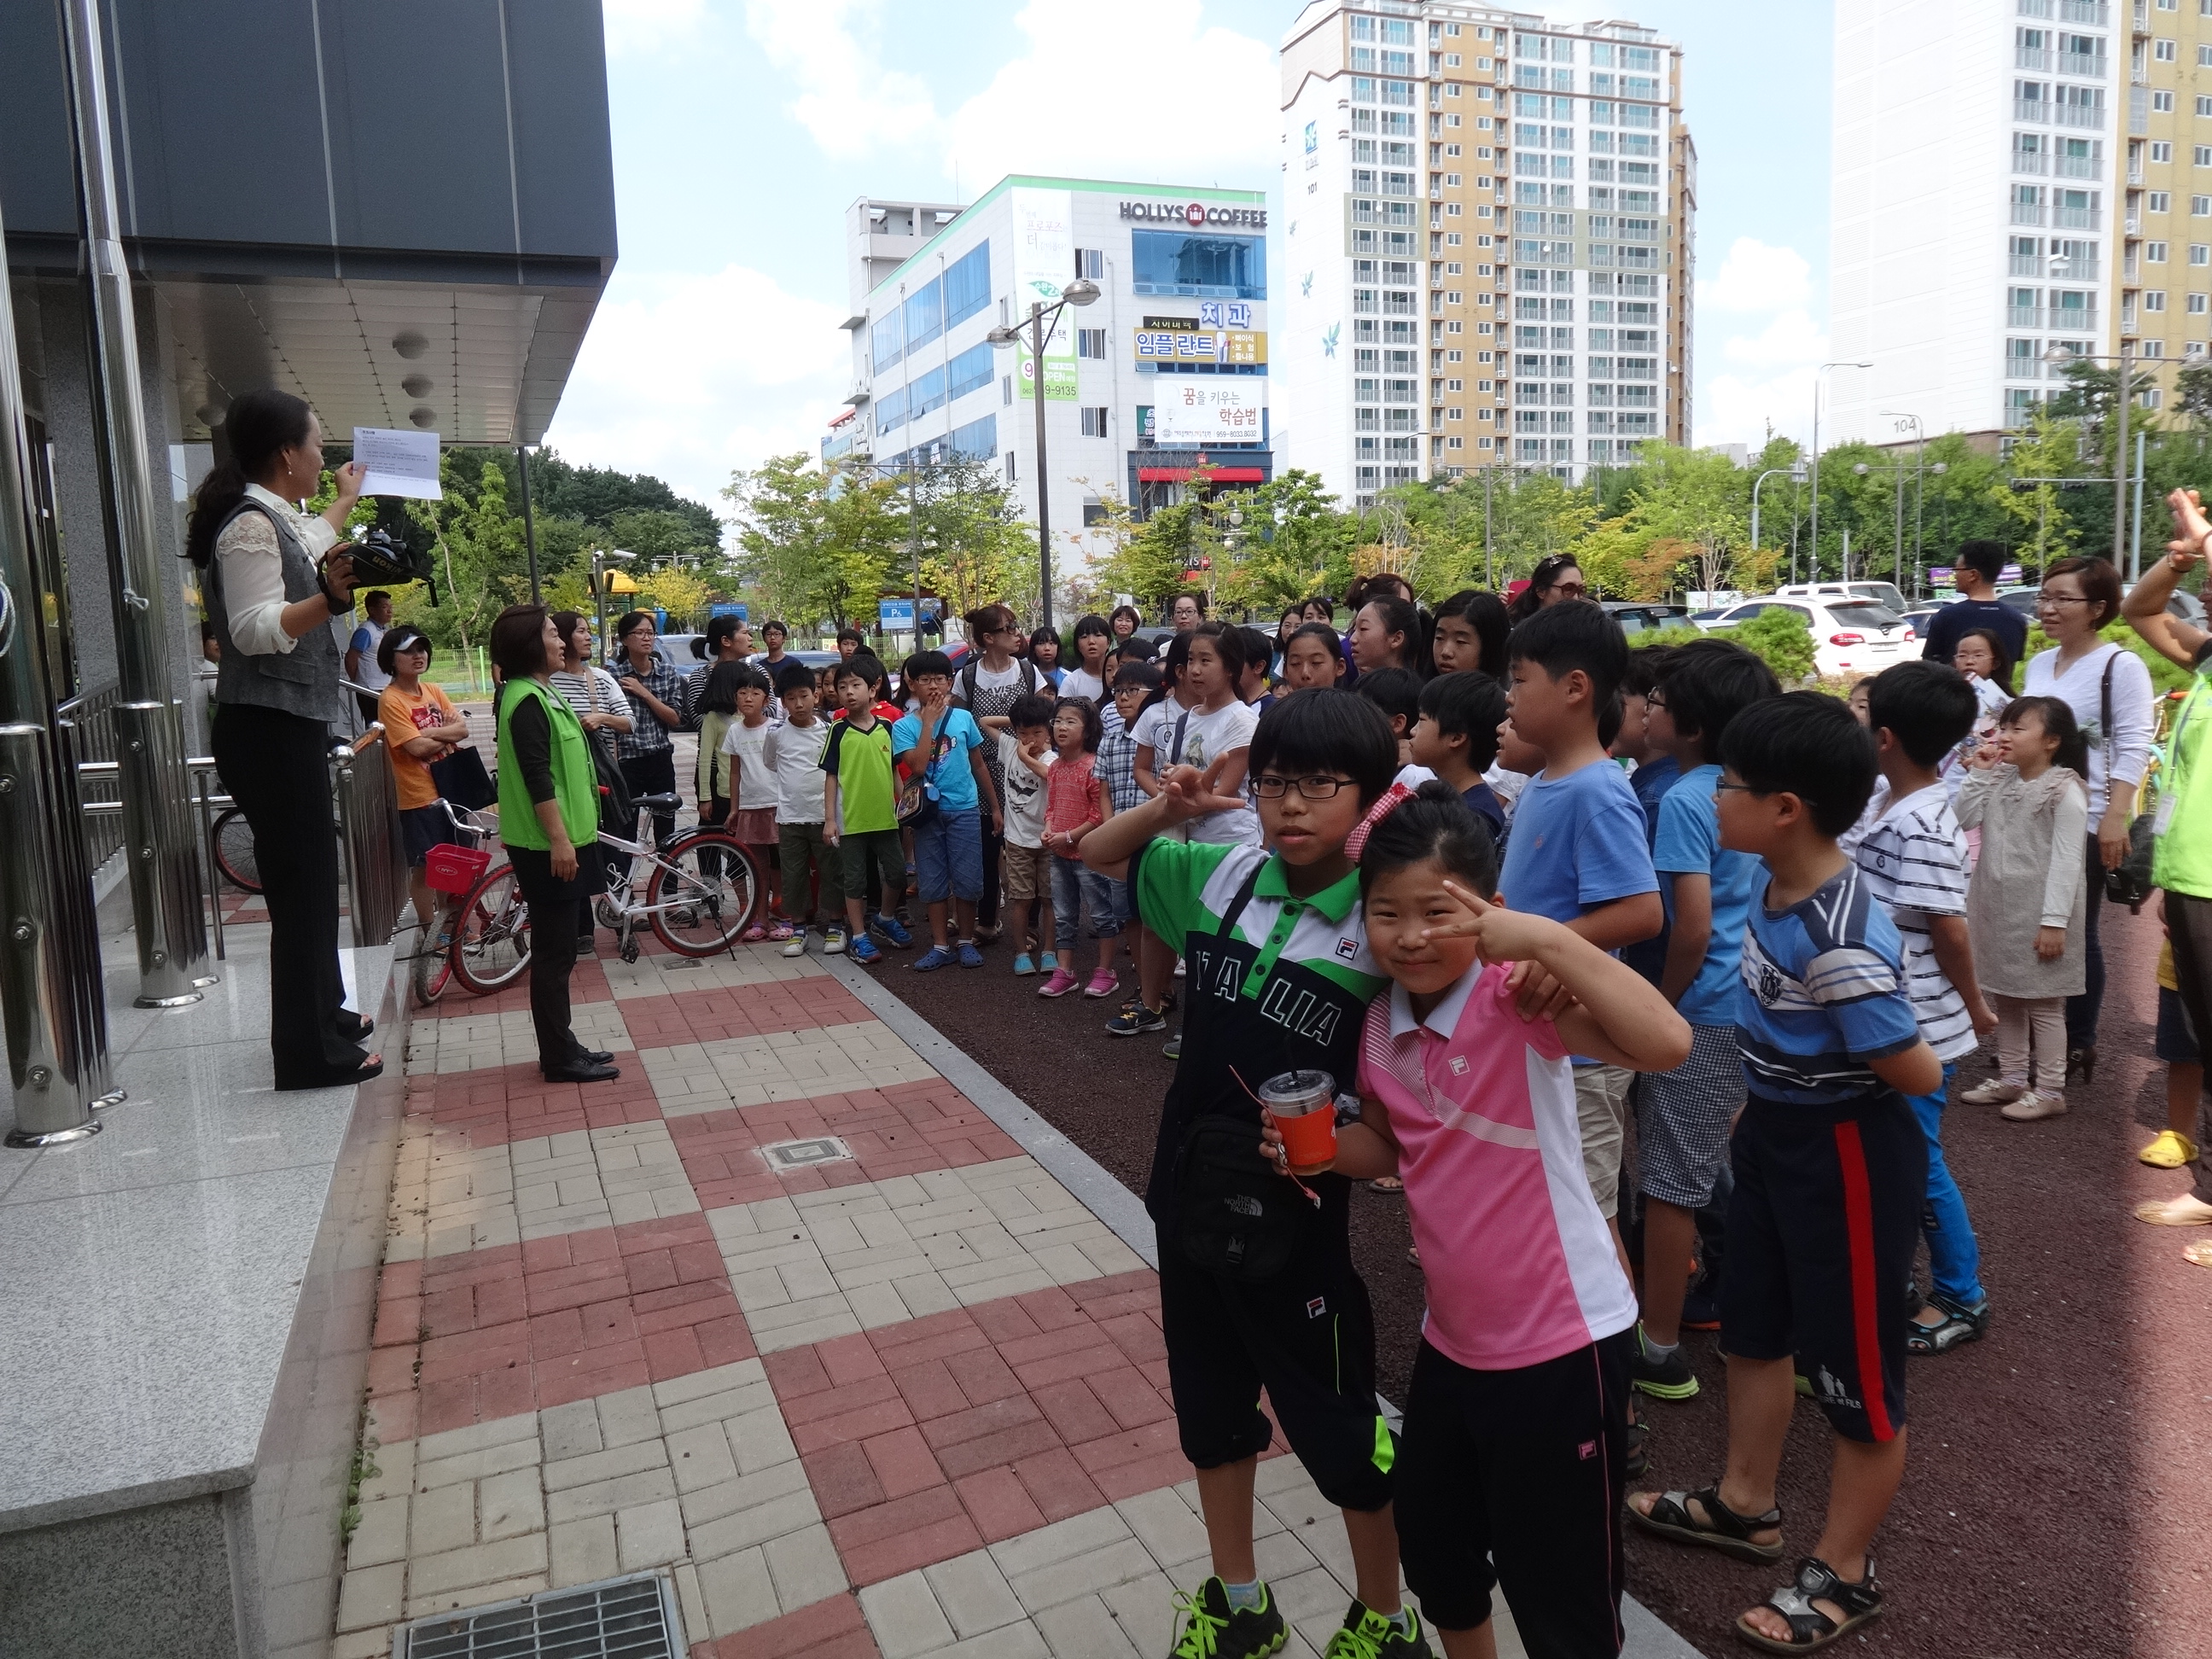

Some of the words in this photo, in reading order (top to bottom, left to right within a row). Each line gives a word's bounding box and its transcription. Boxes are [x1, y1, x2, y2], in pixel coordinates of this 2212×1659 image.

[1307, 181, 1318, 195] 101
[1120, 201, 1185, 222] HOLLYS
[1206, 207, 1268, 228] COFFEE
[1202, 302, 1251, 328] 치과
[1137, 333, 1215, 358] 임플란트
[1183, 387, 1207, 405] 꿈을
[1210, 391, 1241, 405] 키우는
[1220, 407, 1257, 426] 학습법
[1894, 417, 1916, 434] 104
[1224, 1197, 1251, 1210] NORTH
[1237, 1194, 1251, 1203] THE
[1230, 1204, 1249, 1215] FACE
